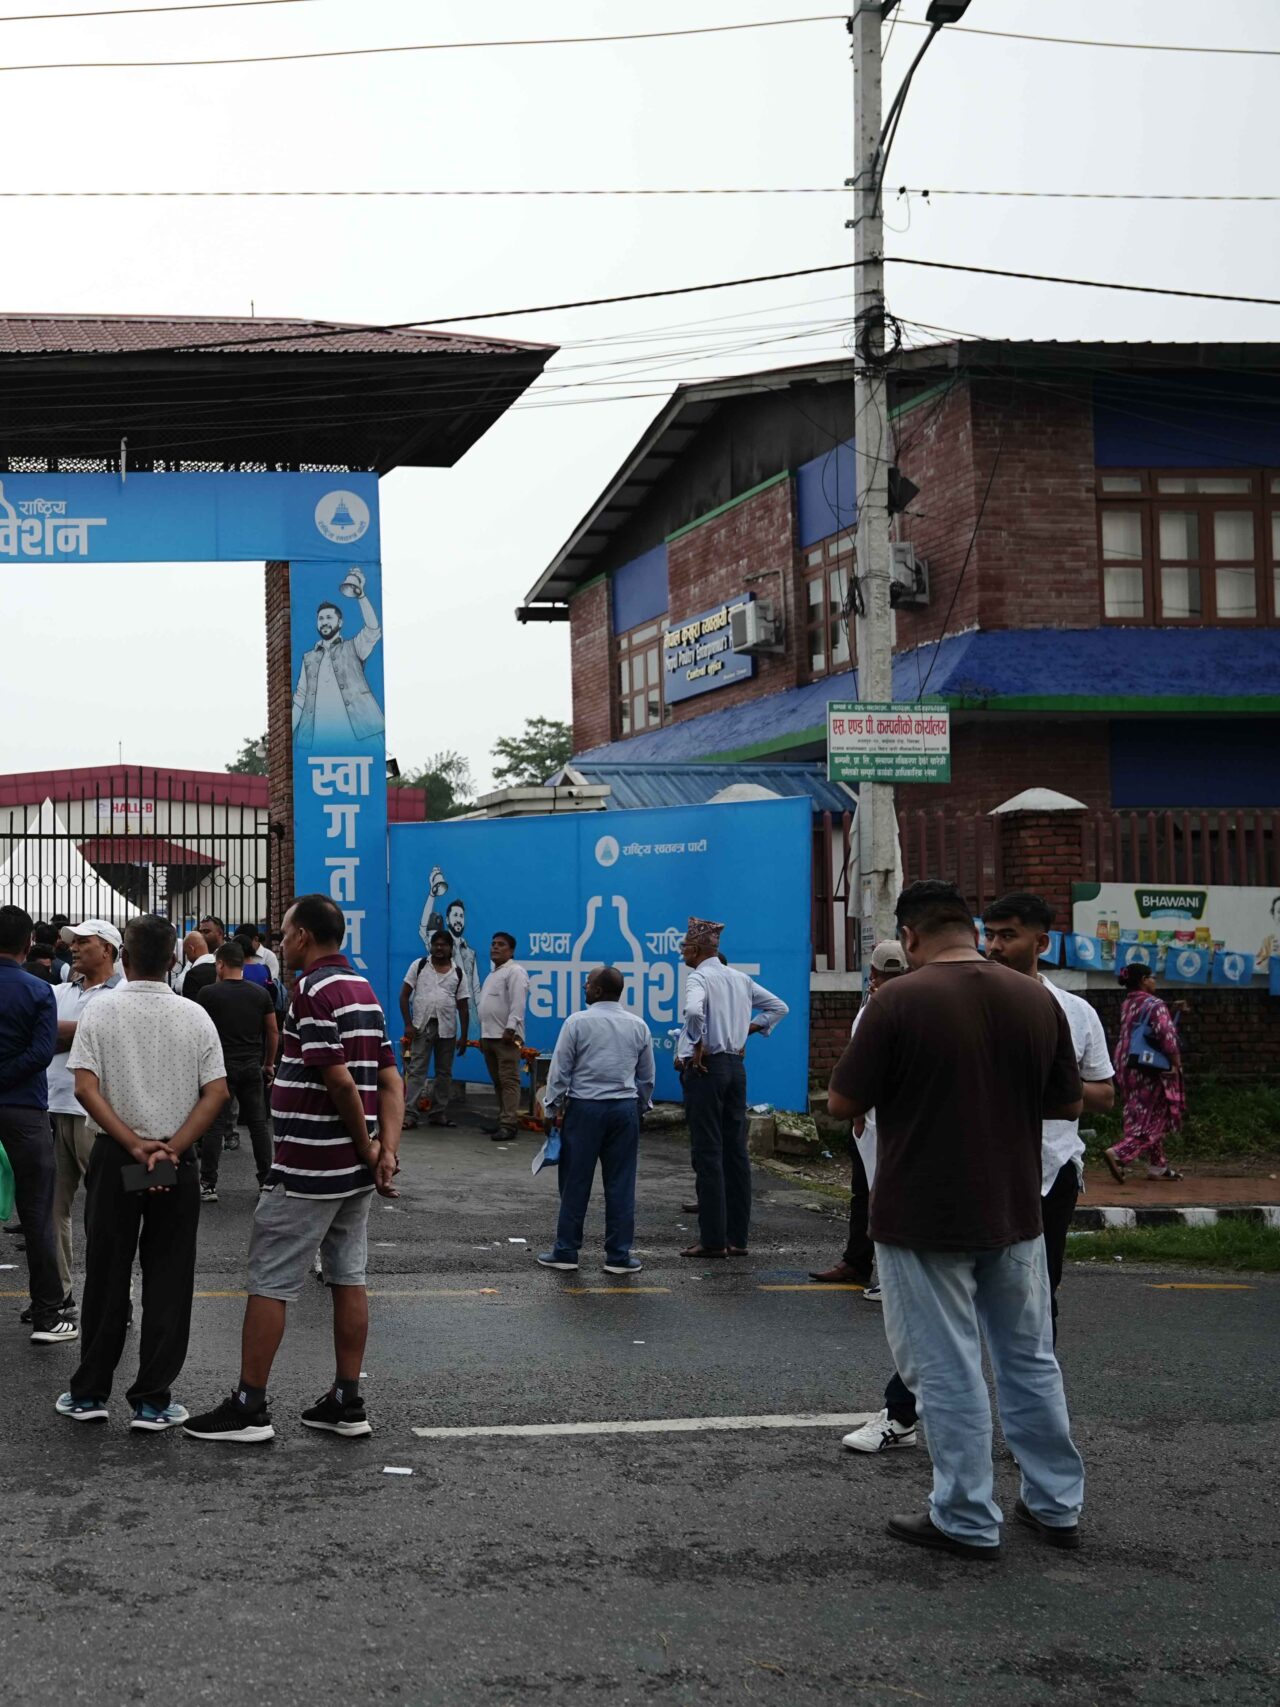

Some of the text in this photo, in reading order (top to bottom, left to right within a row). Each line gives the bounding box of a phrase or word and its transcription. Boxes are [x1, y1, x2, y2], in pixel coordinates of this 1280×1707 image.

[18, 498, 67, 518] राष्ट्रिय
[848, 719, 863, 735] एण्ड
[877, 715, 912, 735] कम्पनीको
[915, 715, 947, 736] कार्यालय
[112, 803, 153, 813] HALL-B
[1142, 895, 1199, 908] BHAWANI
[529, 932, 571, 956] प्रथम
